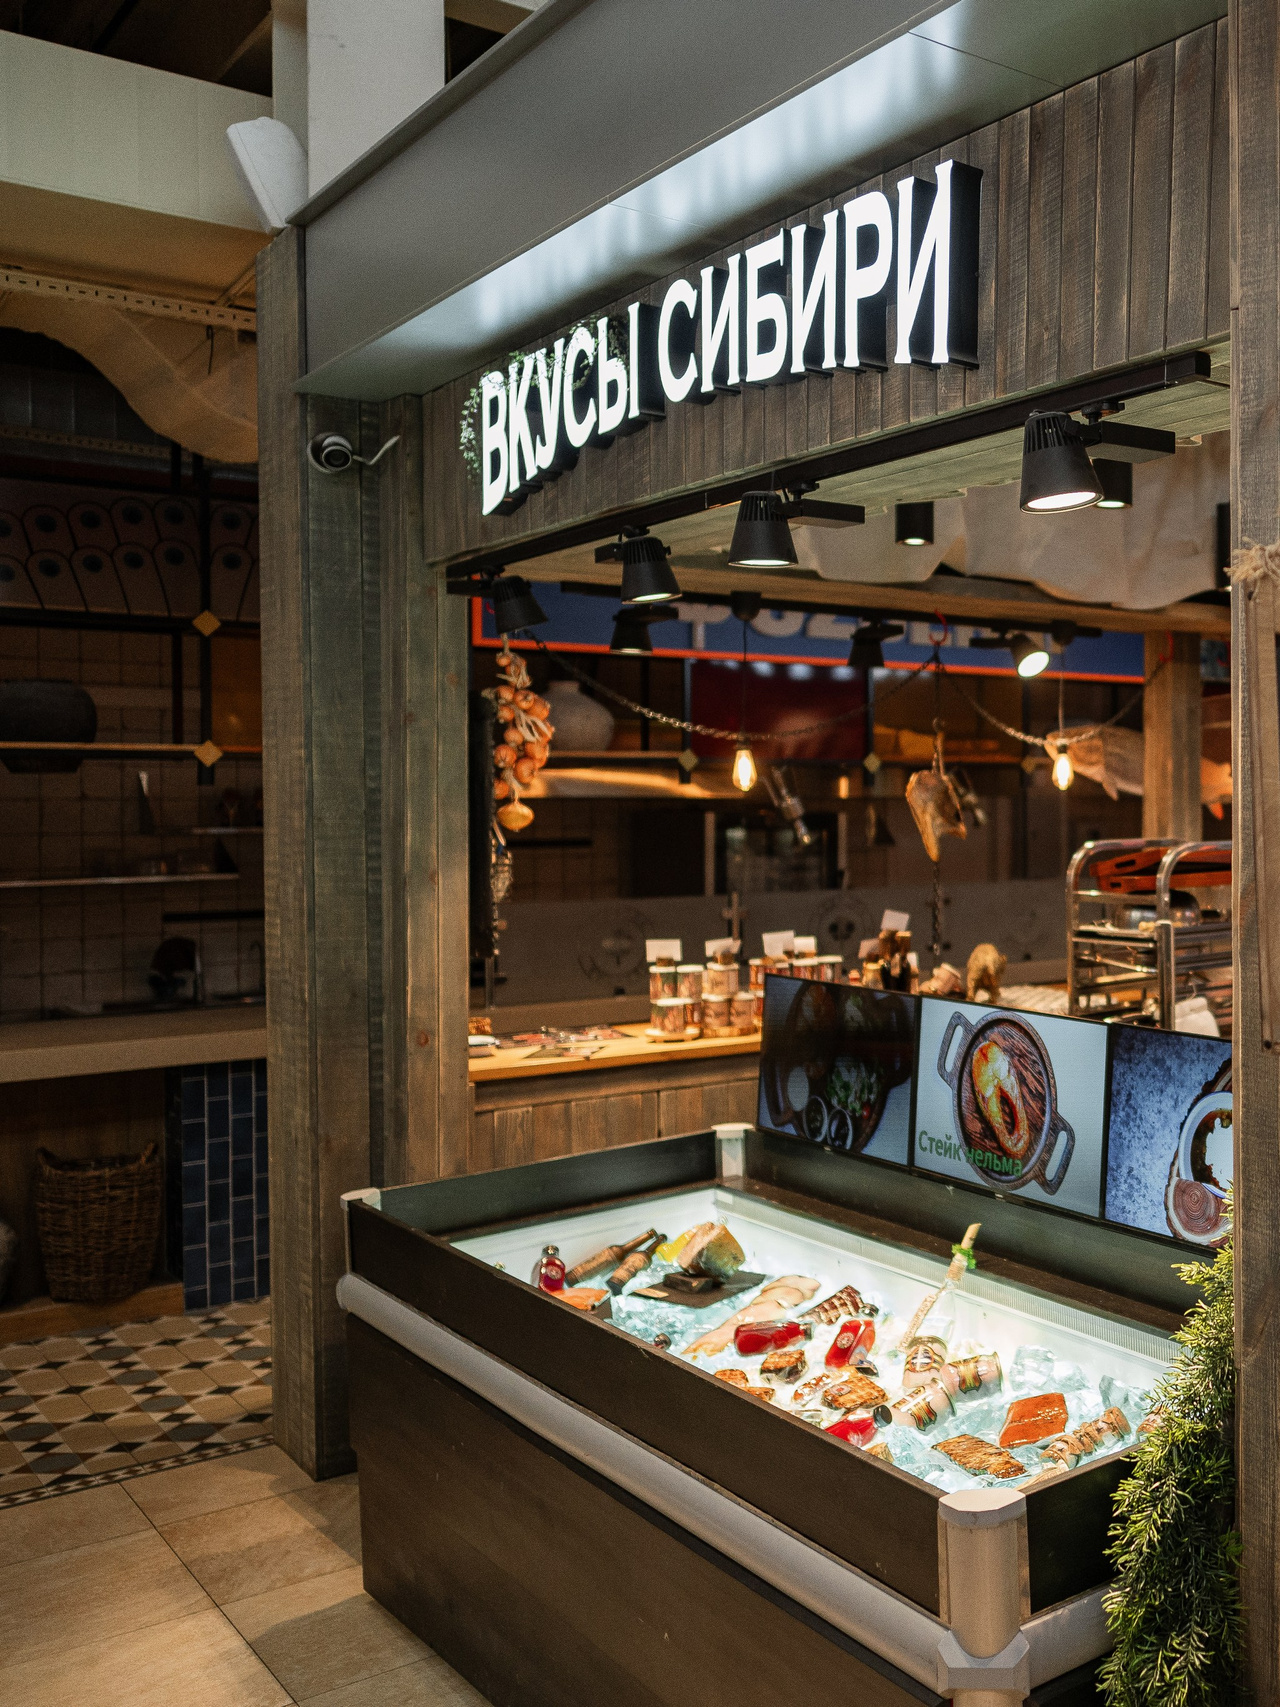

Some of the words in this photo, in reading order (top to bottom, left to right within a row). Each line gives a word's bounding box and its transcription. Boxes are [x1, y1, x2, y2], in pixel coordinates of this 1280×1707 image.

[481, 301, 641, 516] ВКУСЫ
[657, 158, 955, 403] СИБИРИ
[918, 1130, 962, 1161] Стейк
[966, 1147, 1022, 1177] нельма
